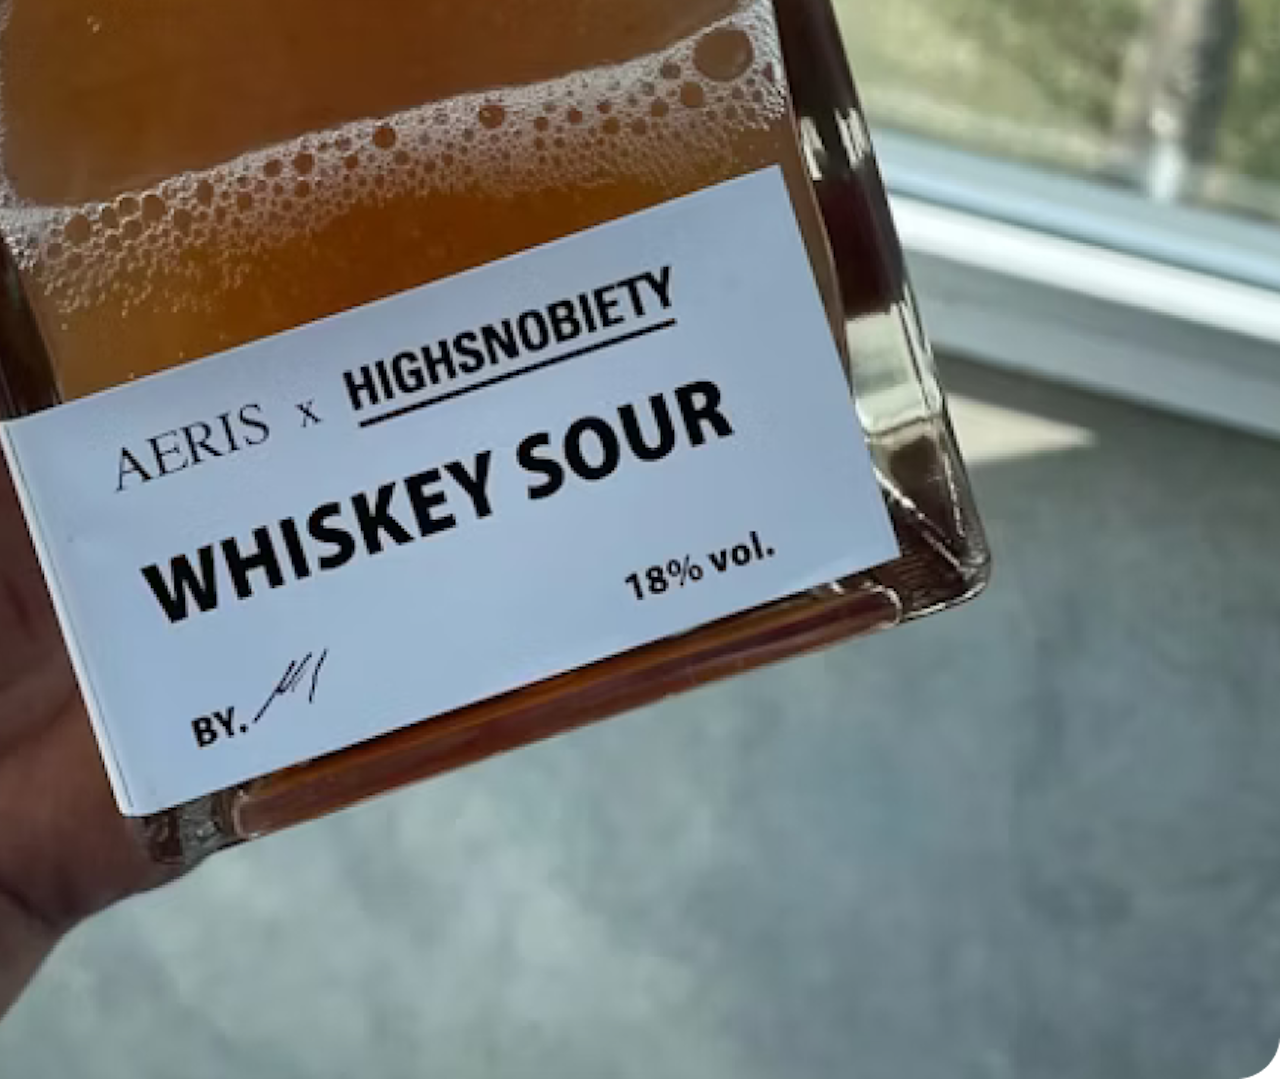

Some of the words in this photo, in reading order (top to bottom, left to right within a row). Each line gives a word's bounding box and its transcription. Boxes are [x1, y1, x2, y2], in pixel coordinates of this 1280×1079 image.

[115, 404, 270, 493] AERIS
[343, 266, 673, 411] HIGHSNOBIETY
[141, 450, 495, 625] WHISKEY
[516, 378, 734, 501] SOUR
[624, 553, 704, 601] 18%
[707, 530, 776, 573] vol.
[191, 706, 249, 748] BY.
